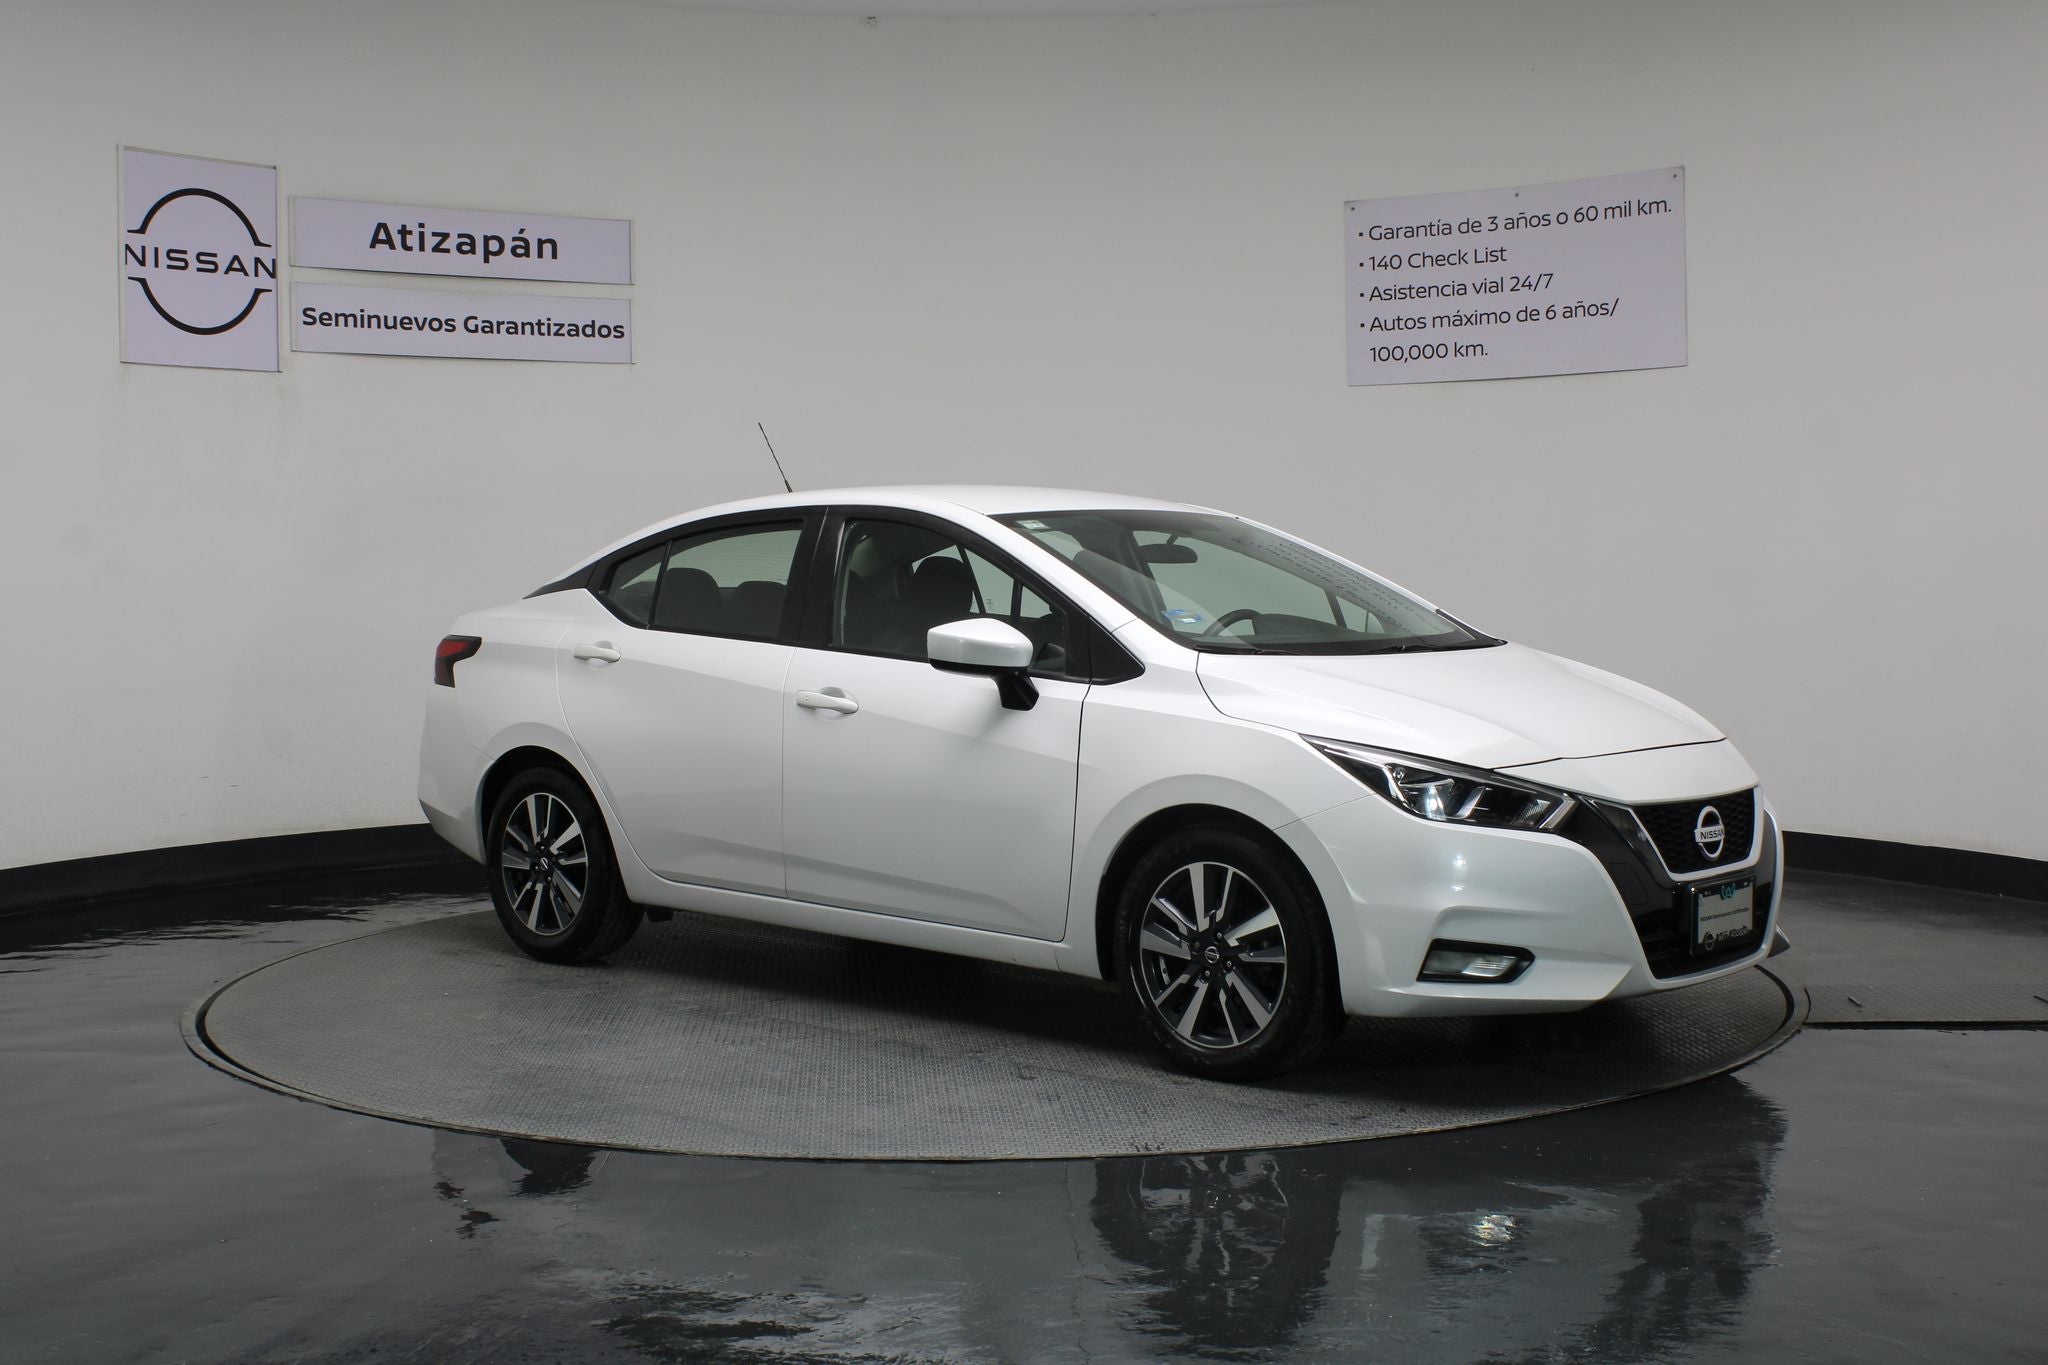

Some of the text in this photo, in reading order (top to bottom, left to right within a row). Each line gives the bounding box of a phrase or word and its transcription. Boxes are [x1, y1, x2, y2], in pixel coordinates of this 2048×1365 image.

[1368, 198, 1672, 241] Garantía de 3 años o 60 mil km.
[369, 222, 558, 264] Atizapán
[1368, 246, 1508, 272] 140 Check List
[123, 242, 278, 281] NISSAN
[1368, 272, 1554, 302] Asistencia vial 24/7
[302, 307, 625, 339] Seminuevos Garantizados
[1369, 297, 1620, 333] Autos máximo de 6 años/
[1369, 341, 1489, 364] 100,000 km.
